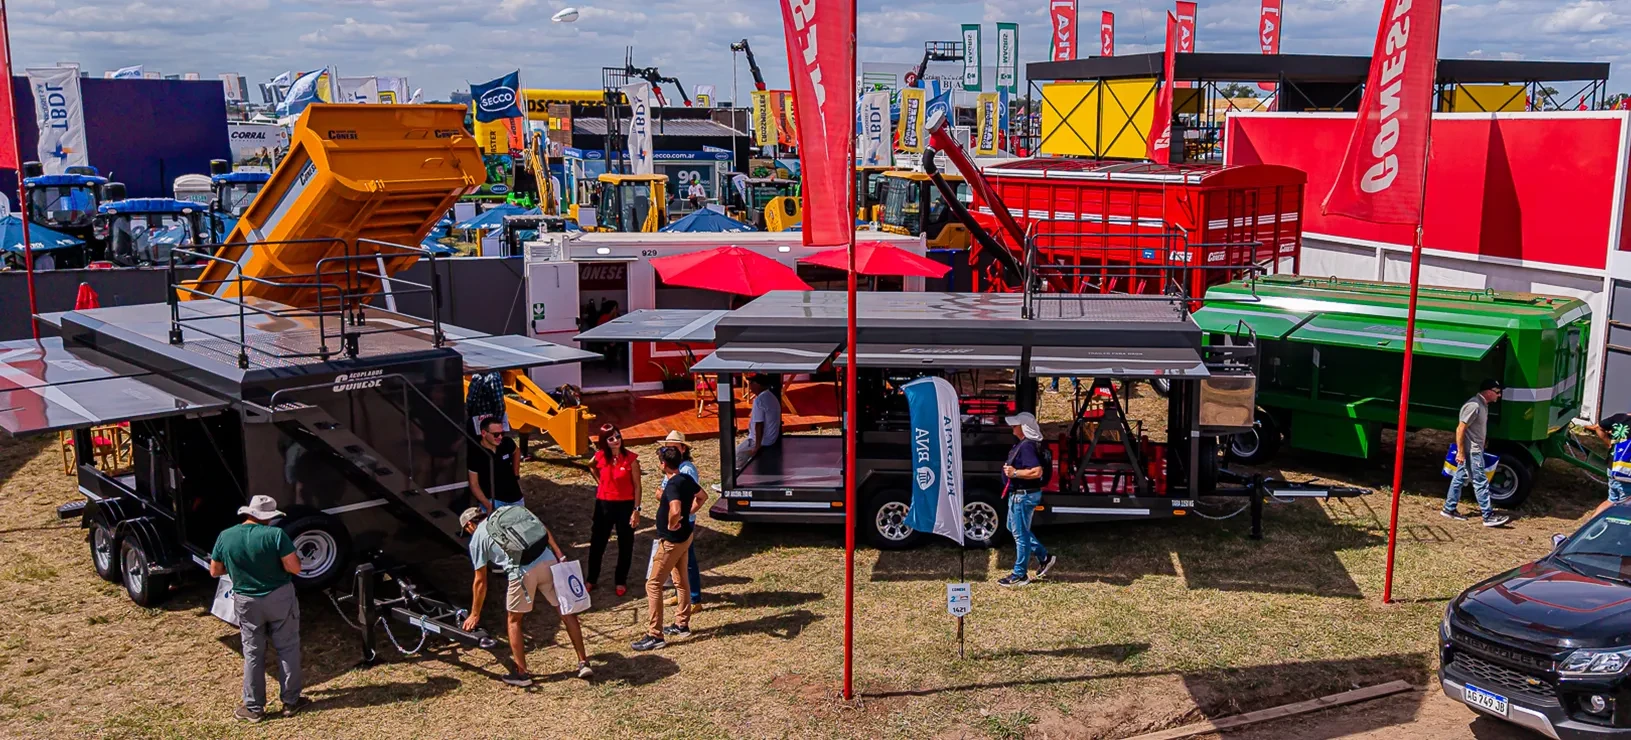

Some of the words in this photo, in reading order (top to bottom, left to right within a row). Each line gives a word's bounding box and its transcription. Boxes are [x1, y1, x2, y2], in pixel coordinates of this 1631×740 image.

[482, 92, 513, 107] SECCO
[231, 131, 266, 139] CORRAL
[641, 249, 658, 257] 929
[580, 265, 624, 280] ONESE
[349, 369, 384, 379] ACOPLADOS
[333, 374, 383, 392] CONESE
[1467, 689, 1477, 701] AG
[1478, 693, 1494, 708] 749
[1495, 701, 1505, 713] JB
